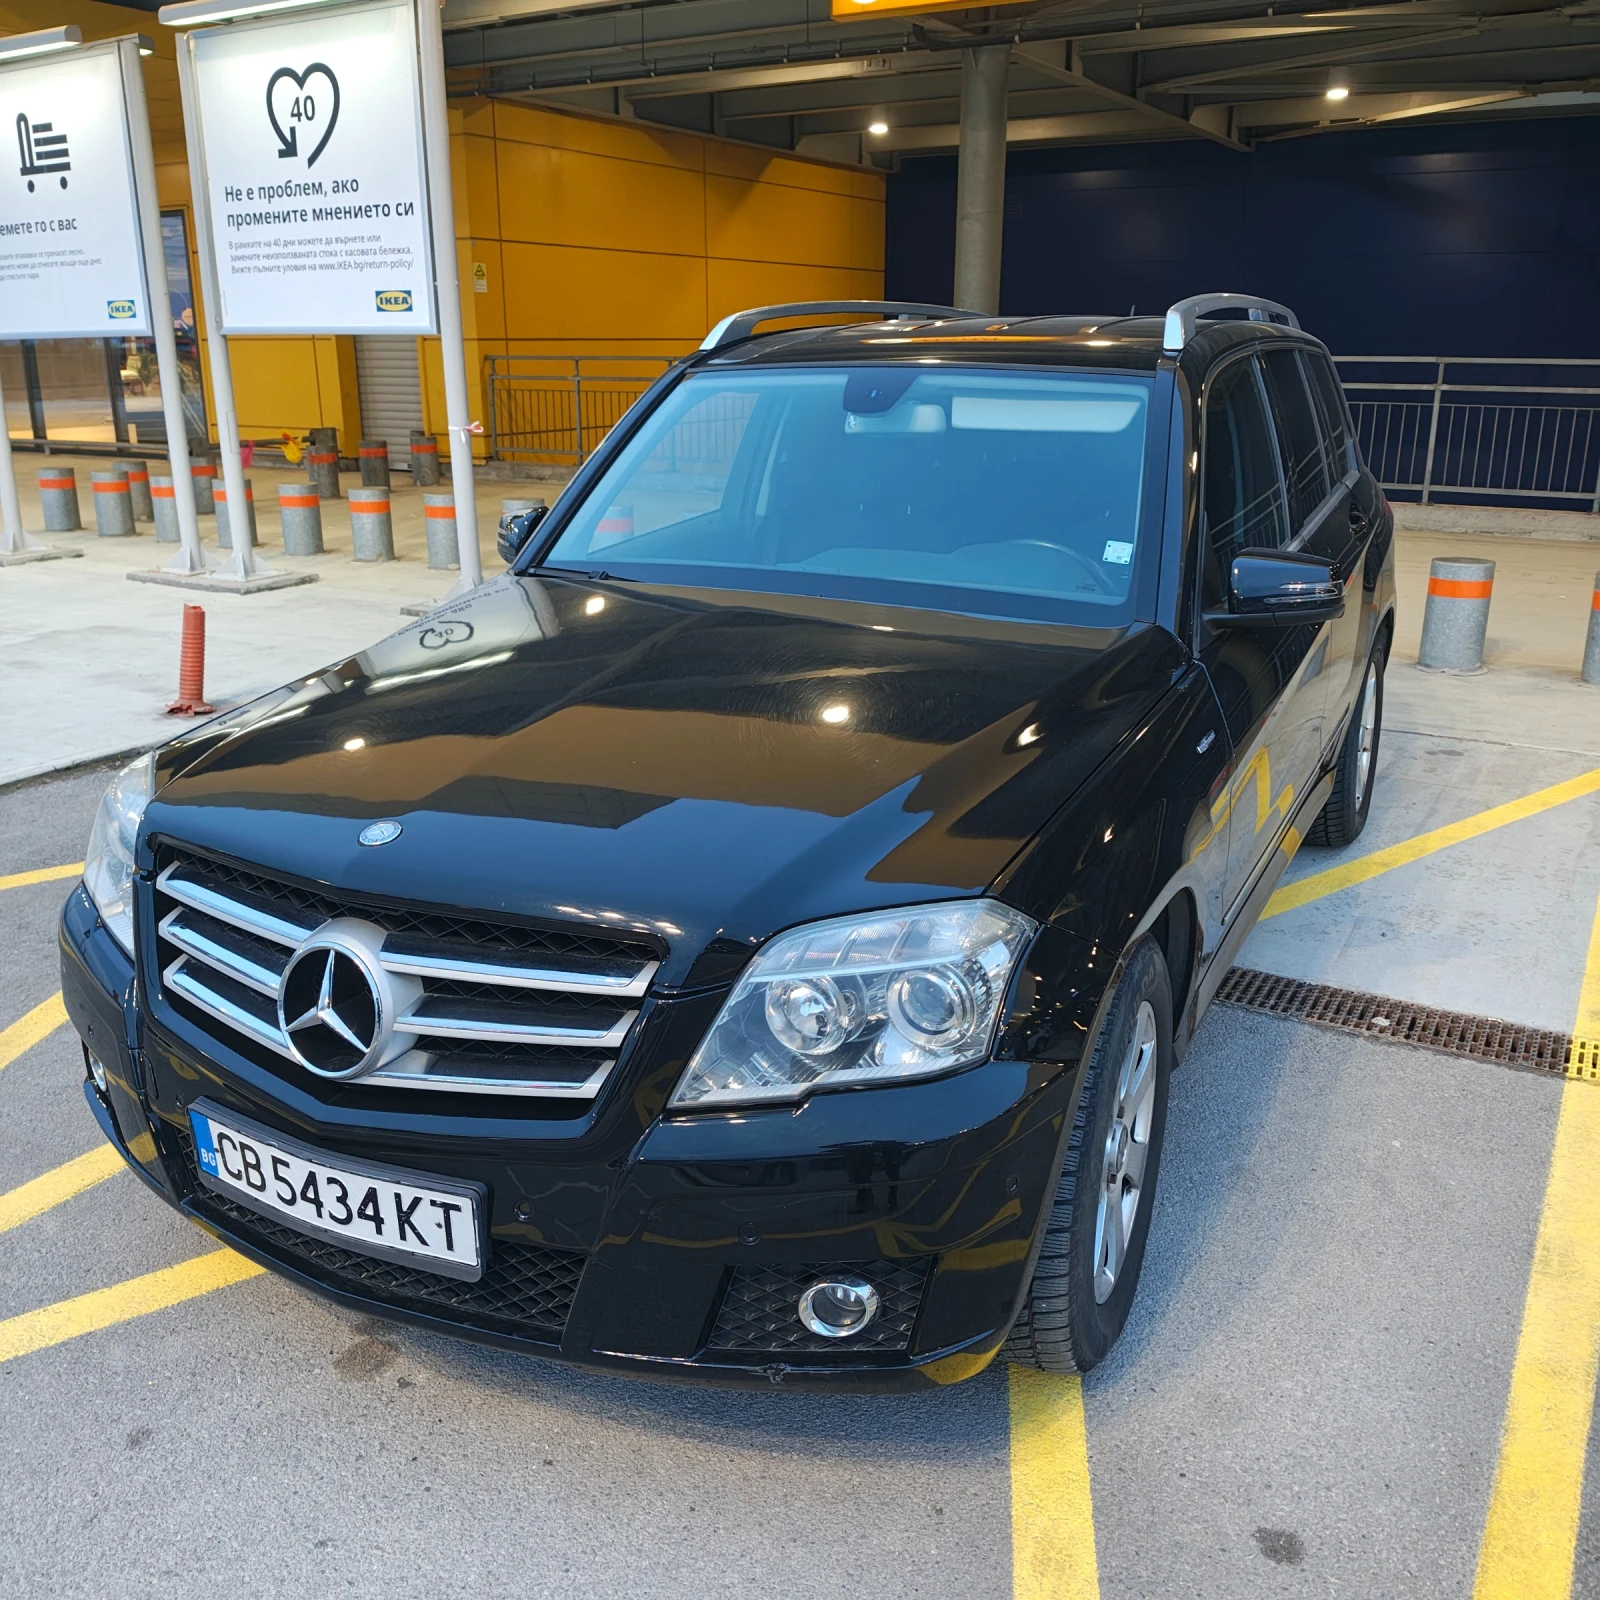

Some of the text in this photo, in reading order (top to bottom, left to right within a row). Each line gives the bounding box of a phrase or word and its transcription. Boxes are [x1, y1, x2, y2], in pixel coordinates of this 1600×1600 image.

[290, 94, 316, 123] 40
[224, 178, 360, 205] Не е проблем, ако
[35, 220, 47, 234] го
[49, 219, 56, 232] с
[58, 217, 78, 231] вас
[227, 201, 415, 232] промените мнението си
[228, 234, 382, 252] В рамките на 40 дни можете да върнете или
[229, 245, 413, 262] замените неизползваната стока с касовата бележка.
[231, 265, 252, 275] Вижте
[253, 264, 281, 274] пълните
[308, 263, 317, 271] на
[110, 305, 133, 314] IKEA
[379, 296, 410, 306] IKEA
[200, 1147, 217, 1168] BG
[216, 1130, 463, 1252] CB 5434 KT
